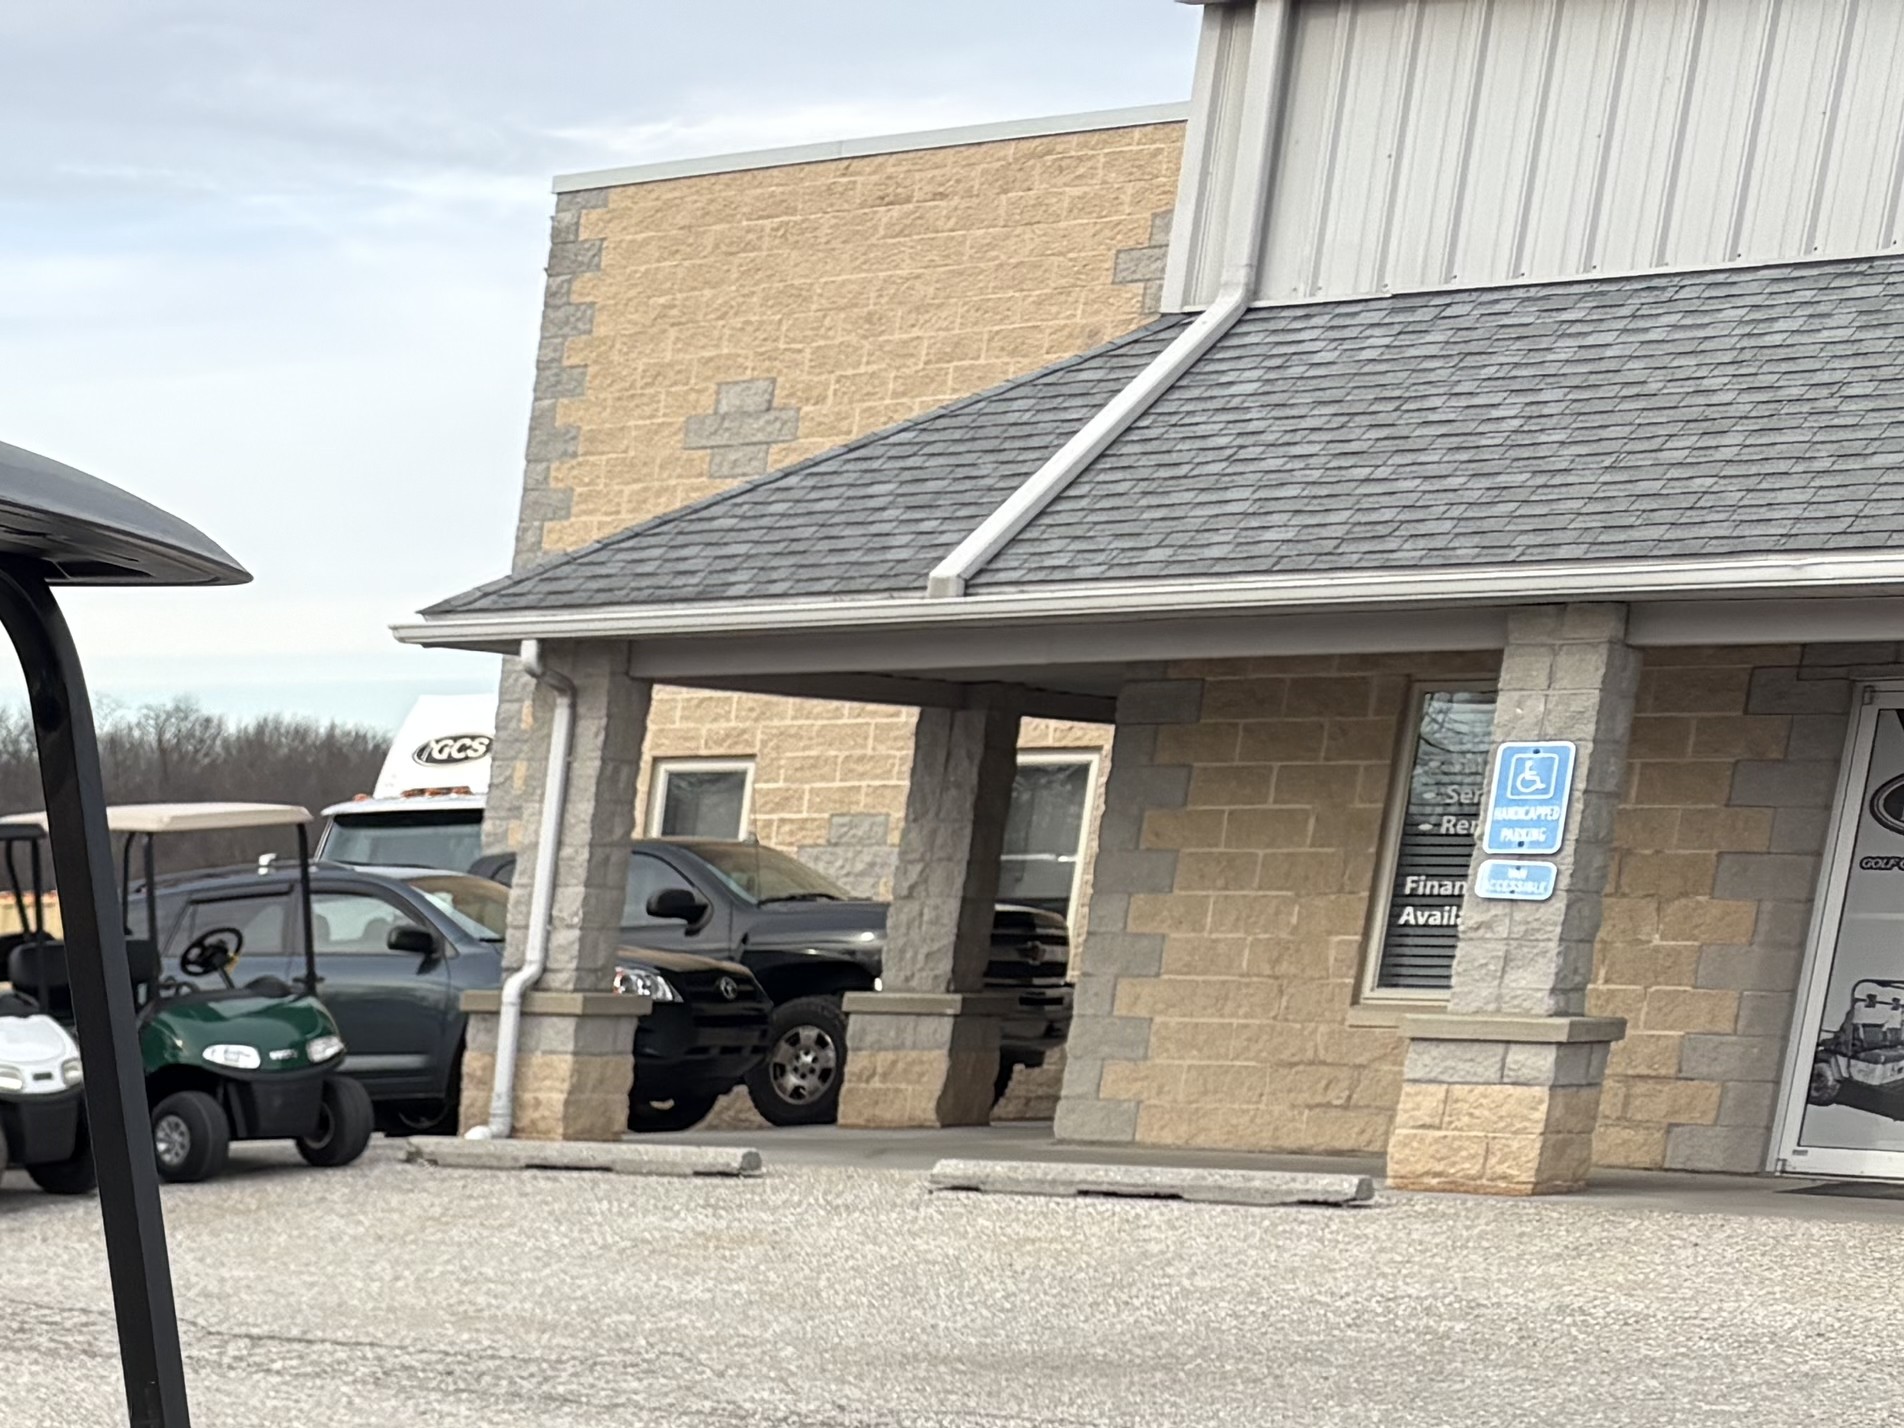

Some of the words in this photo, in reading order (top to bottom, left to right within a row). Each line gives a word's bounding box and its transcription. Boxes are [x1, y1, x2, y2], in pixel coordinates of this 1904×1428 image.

[1494, 805, 1561, 821] HANDICAPPED
[1500, 827, 1548, 842] PARKING
[1861, 857, 1900, 869] GOLF
[1398, 906, 1462, 925] Avail
